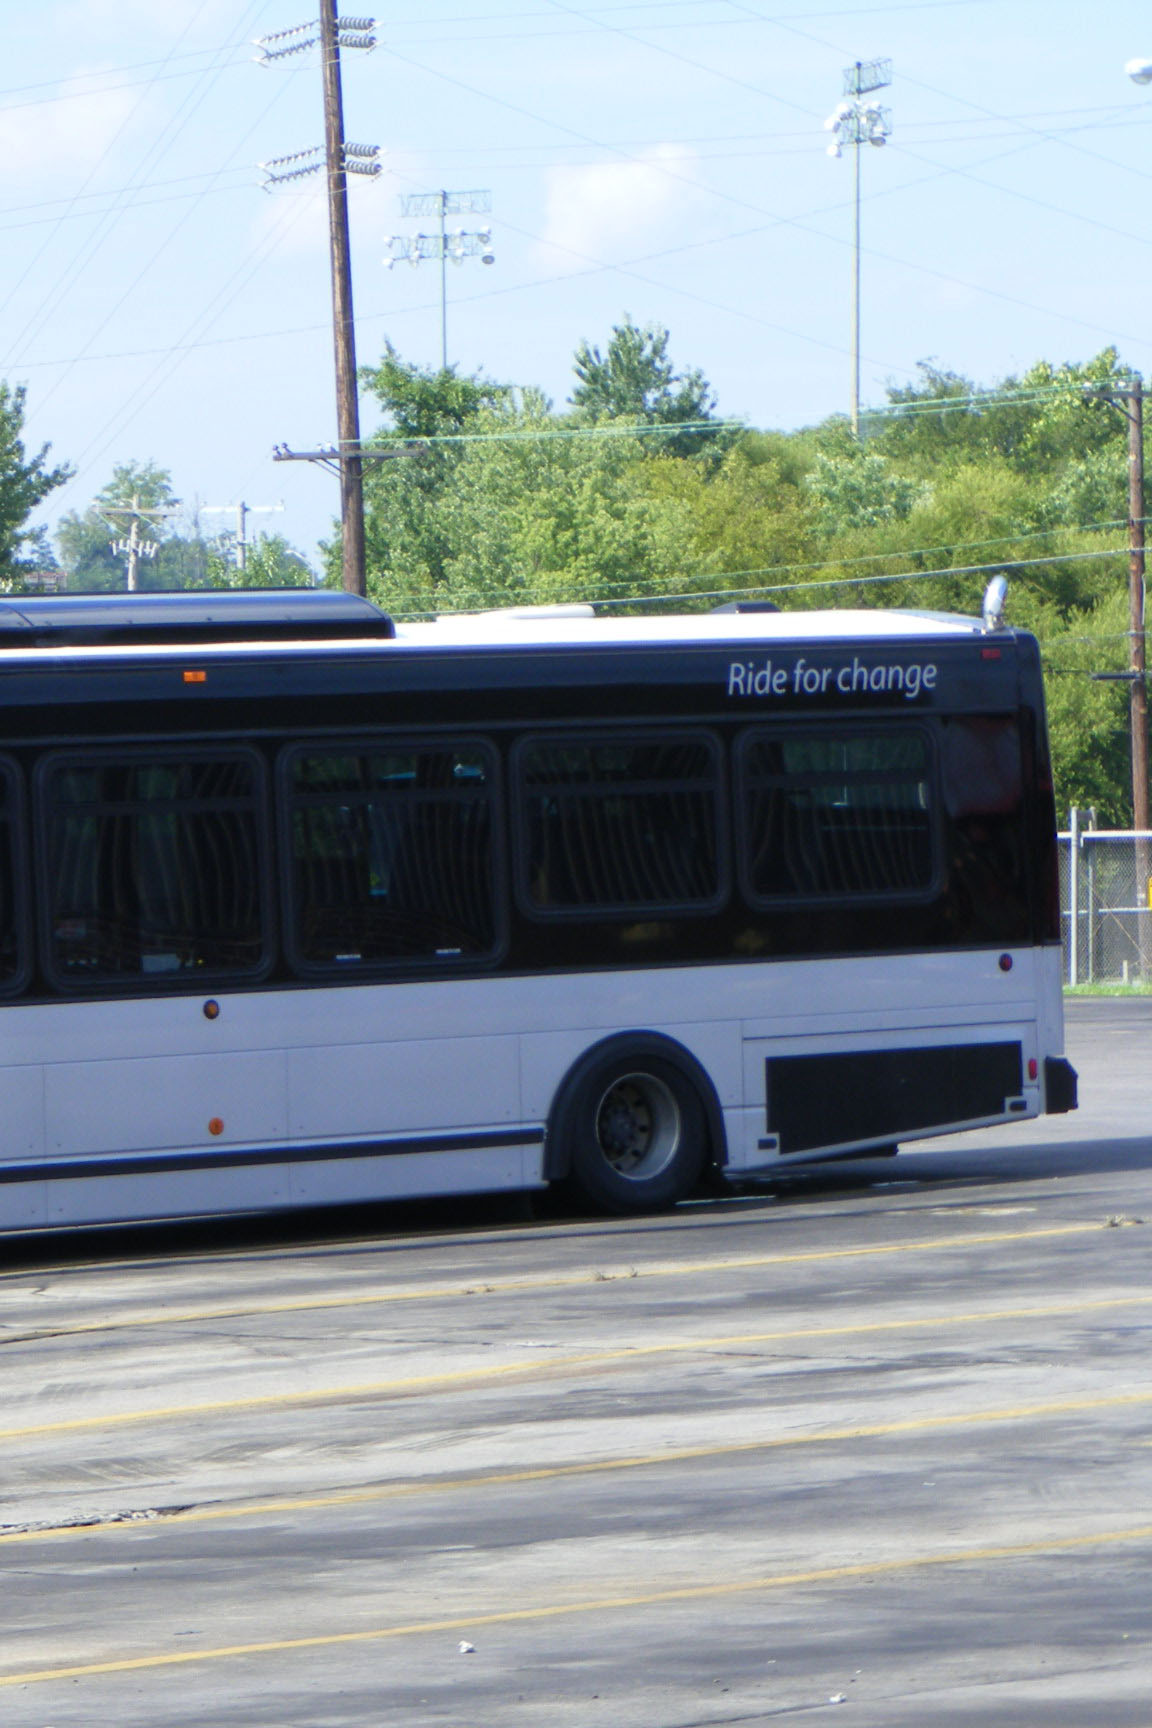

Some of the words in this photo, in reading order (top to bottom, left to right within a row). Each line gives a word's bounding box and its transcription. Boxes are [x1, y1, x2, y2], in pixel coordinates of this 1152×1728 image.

[728, 660, 788, 695] Ride
[794, 658, 832, 693] for
[837, 657, 937, 698] change
